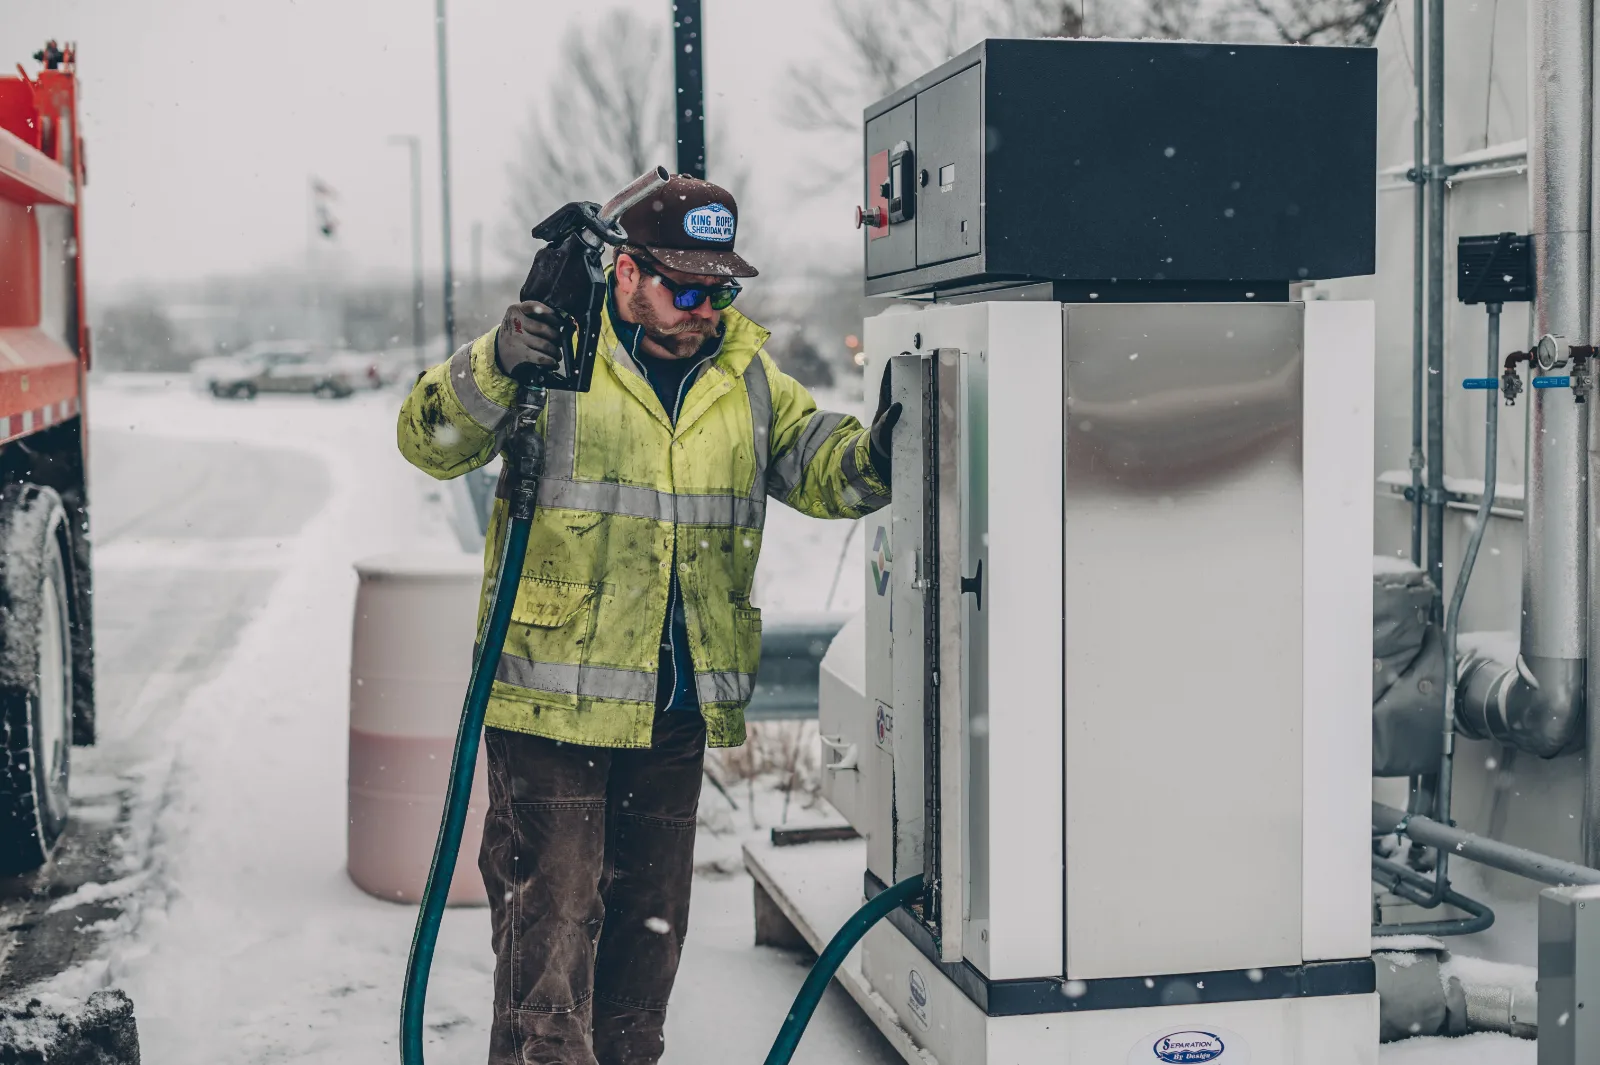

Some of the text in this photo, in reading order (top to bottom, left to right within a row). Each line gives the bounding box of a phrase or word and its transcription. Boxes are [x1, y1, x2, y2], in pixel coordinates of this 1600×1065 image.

[691, 214, 711, 226] KING
[692, 225, 723, 236] SHERIDAN,
[514, 317, 523, 334] 3M
